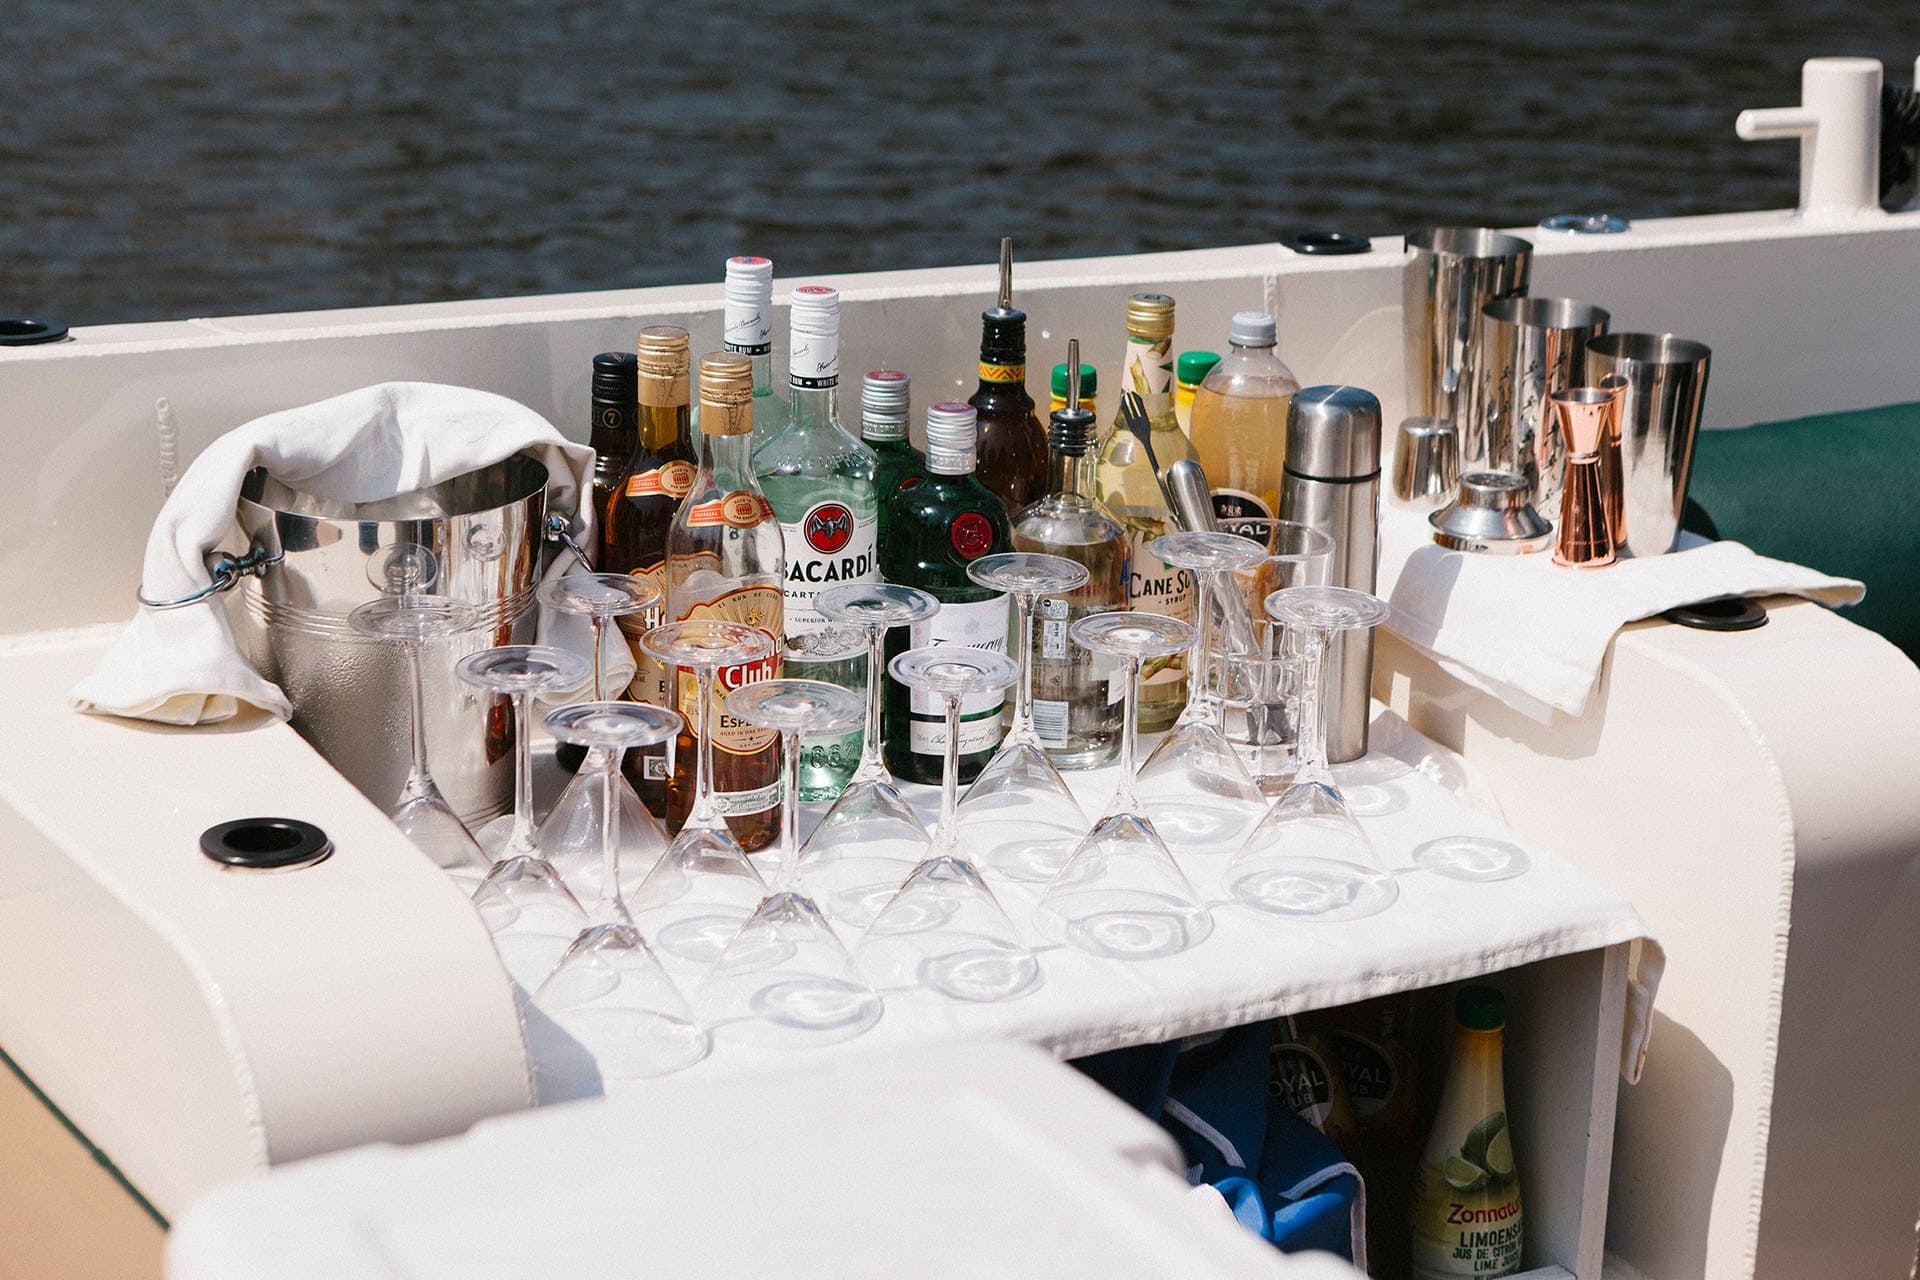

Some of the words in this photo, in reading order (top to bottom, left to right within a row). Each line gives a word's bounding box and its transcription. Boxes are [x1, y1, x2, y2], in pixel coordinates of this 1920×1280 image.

[608, 412, 616, 425] 7
[1230, 524, 1268, 535] YAL
[1130, 572, 1173, 598] CANE
[784, 590, 821, 599] CART
[726, 660, 772, 689] Club
[1349, 1064, 1386, 1084] YAL
[1268, 1070, 1325, 1098] OYAL
[1447, 1200, 1520, 1225] Zonnatu
[1453, 1248, 1472, 1259] JUS
[1476, 1248, 1488, 1259] DE
[1474, 1259, 1498, 1271] LIME
